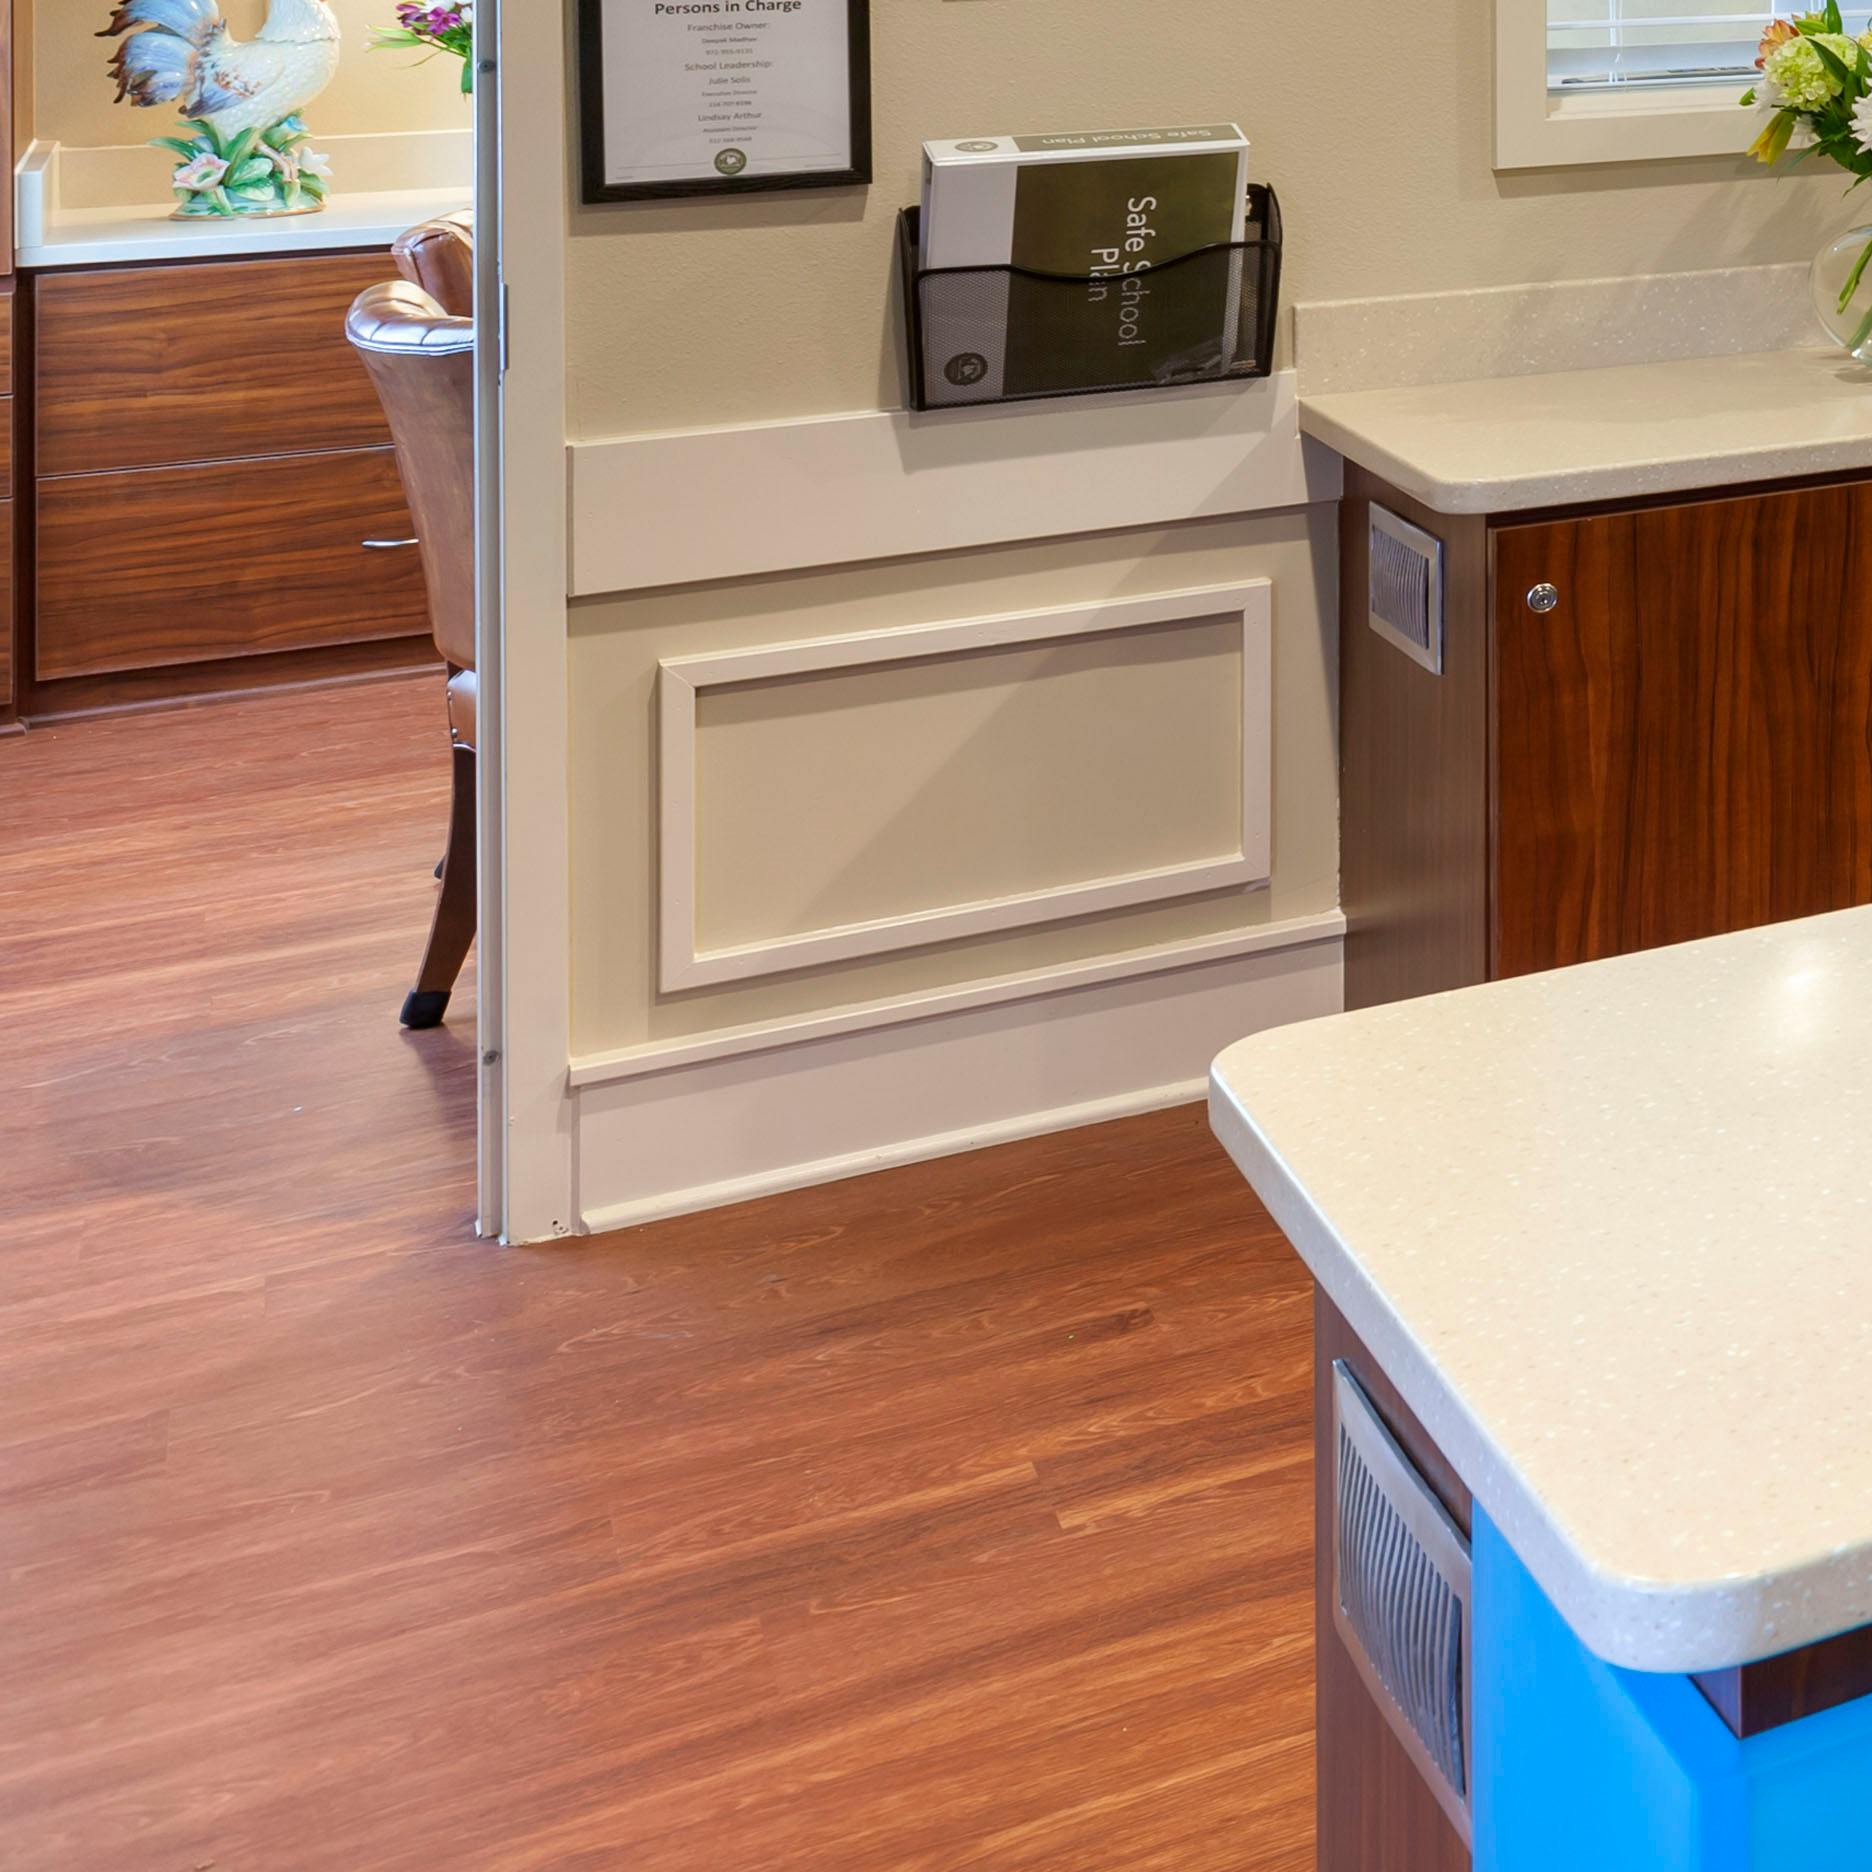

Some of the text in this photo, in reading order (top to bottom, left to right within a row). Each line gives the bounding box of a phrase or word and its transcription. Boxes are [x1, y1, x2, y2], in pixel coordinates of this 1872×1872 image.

[655, 0, 802, 15] Persons in Charge
[687, 22, 733, 32] Franchise
[685, 62, 717, 71] School
[1042, 130, 1212, 146] Safe School Plan
[1118, 196, 1157, 345] Safe School
